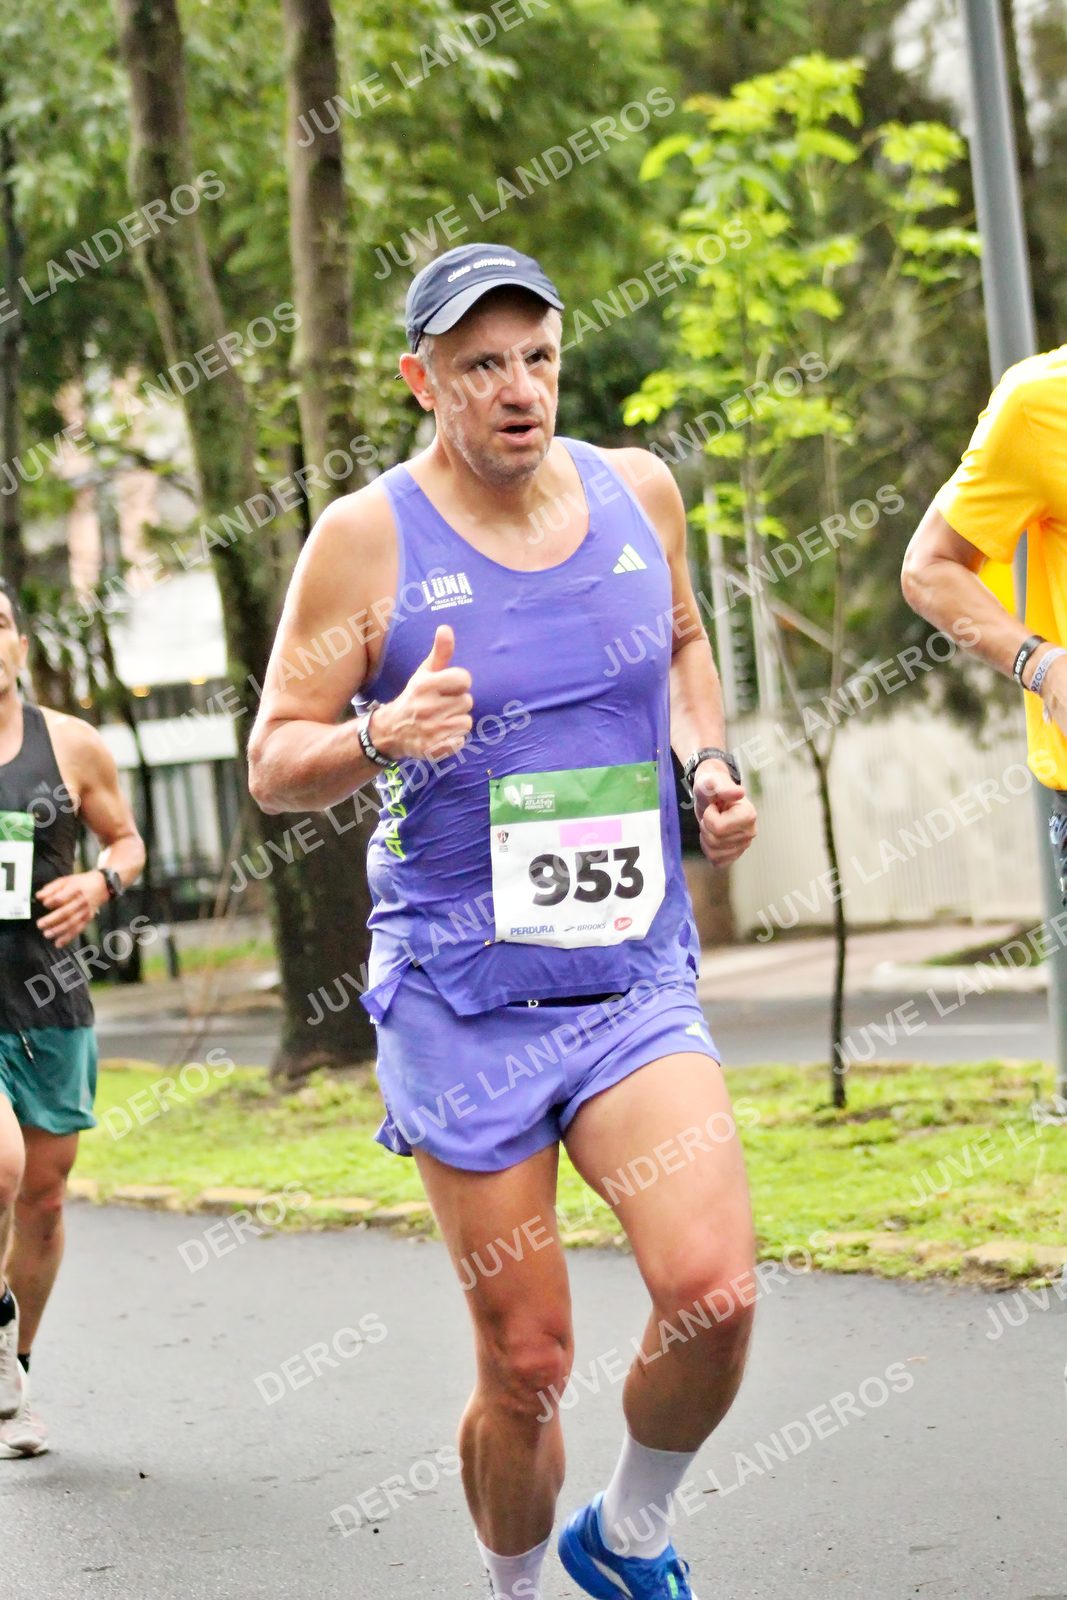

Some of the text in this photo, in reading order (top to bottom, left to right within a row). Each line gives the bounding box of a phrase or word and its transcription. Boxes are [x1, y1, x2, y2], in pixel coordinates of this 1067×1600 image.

[421, 572, 473, 605] LUNA
[528, 846, 644, 906] 953
[510, 925, 555, 936] PERDURA
[576, 921, 607, 931] BROOKS
